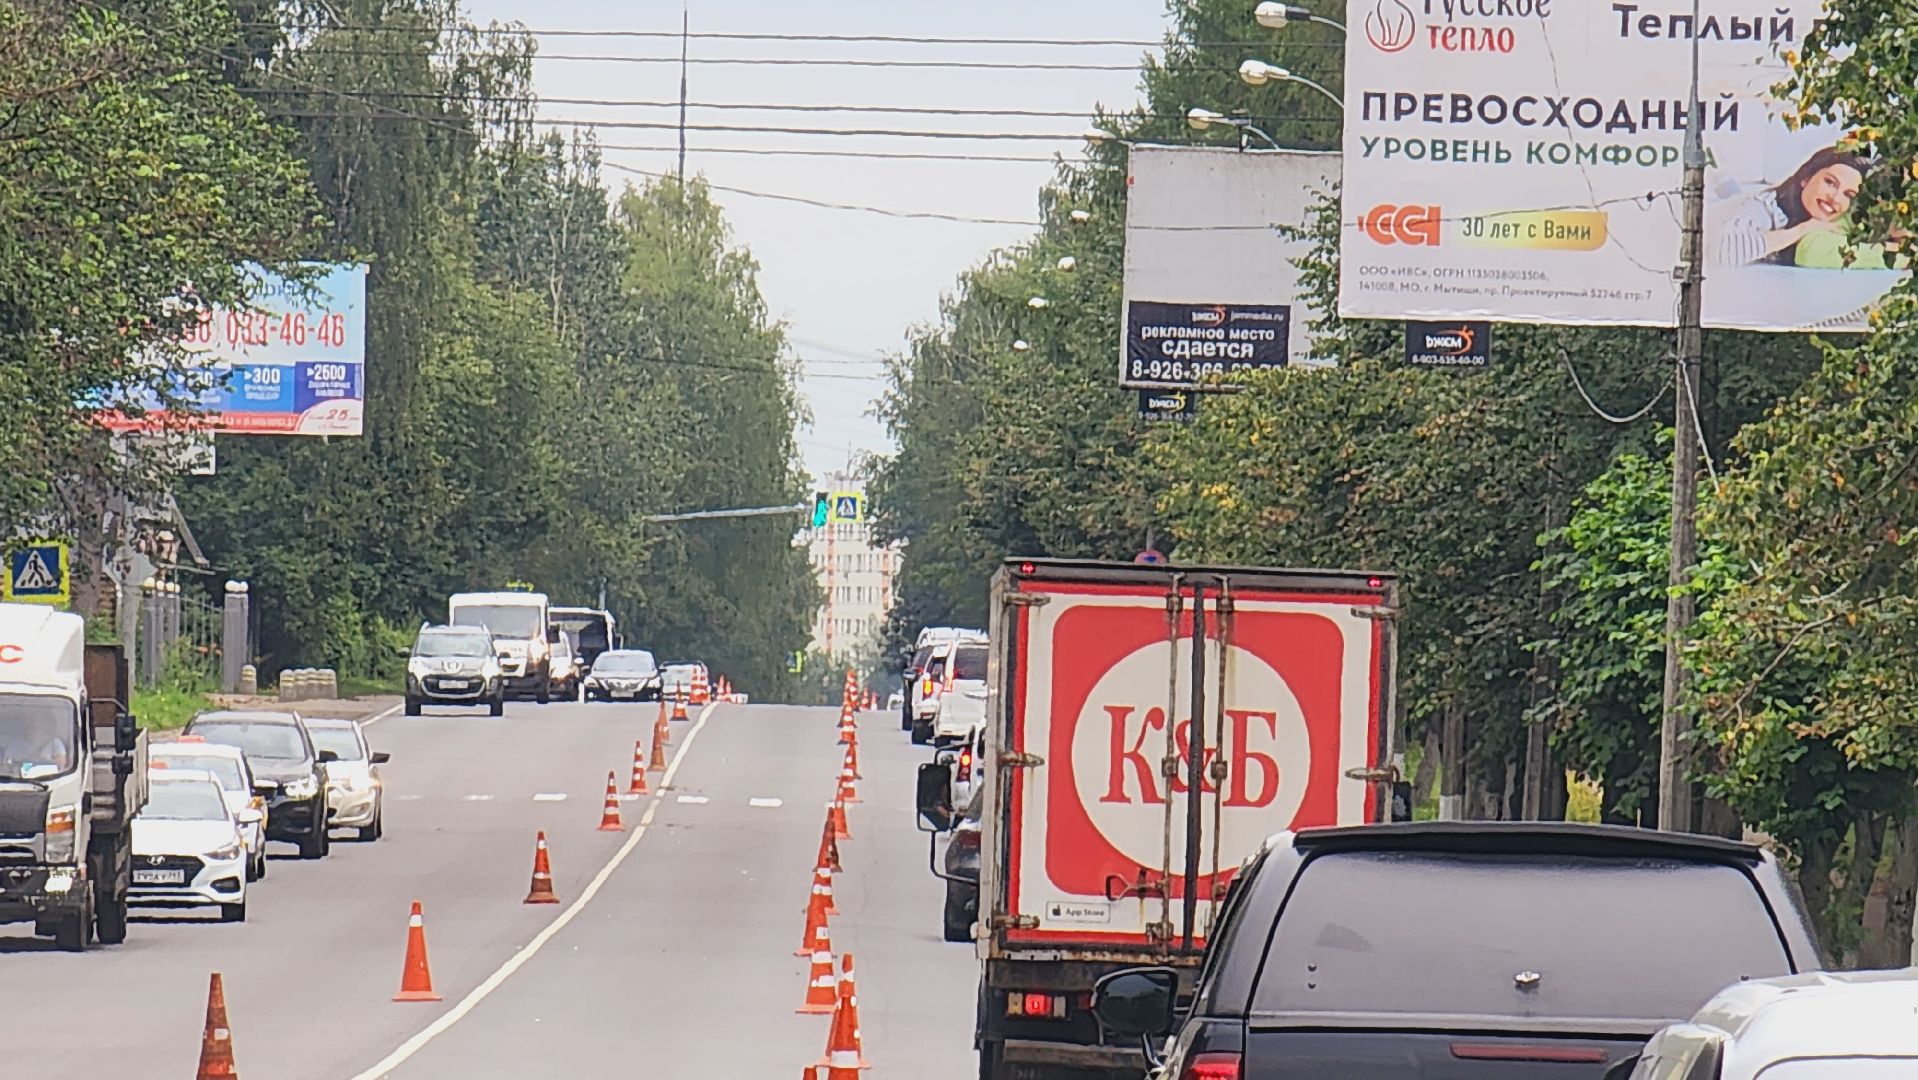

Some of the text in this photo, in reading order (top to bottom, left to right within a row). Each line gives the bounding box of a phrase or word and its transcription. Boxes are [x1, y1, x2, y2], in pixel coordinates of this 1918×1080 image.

[1612, 3, 1794, 42] Теплый
[1426, 25, 1514, 53] тепло
[1362, 91, 1739, 134] ПРЕВОСХОДНЫЙ
[1360, 136, 1512, 164] УРОВЕНЬ
[1462, 217, 1591, 241] 30 лет с Вами
[1161, 340, 1253, 360] сдается
